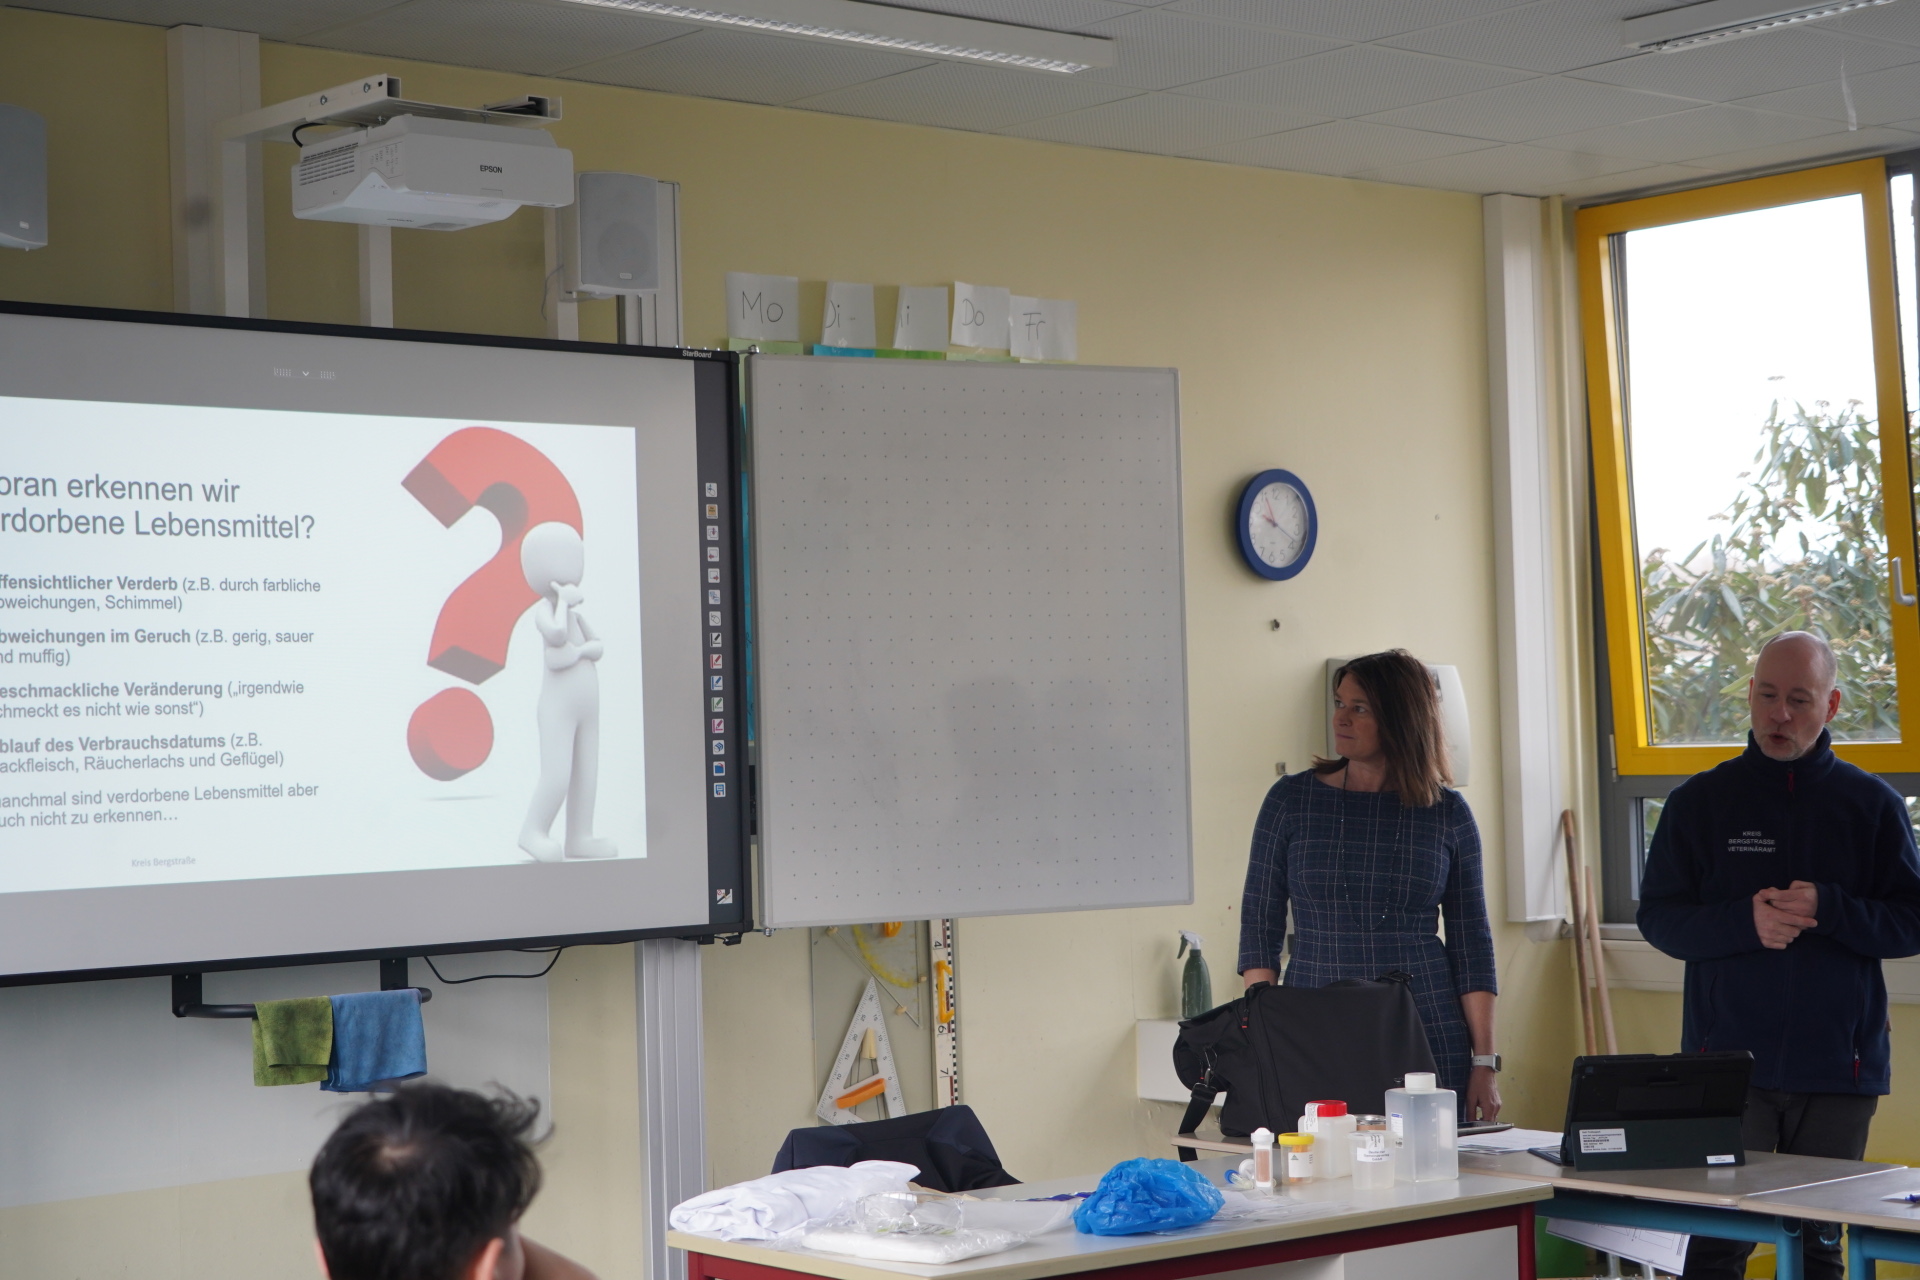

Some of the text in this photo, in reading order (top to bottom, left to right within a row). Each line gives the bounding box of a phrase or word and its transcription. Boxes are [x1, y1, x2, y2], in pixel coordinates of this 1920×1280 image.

[480, 164, 503, 174] EPSON
[742, 291, 783, 324] Mo
[962, 299, 985, 327] Do
[1023, 313, 1046, 341] Fr
[682, 350, 712, 359] StarBoard
[67, 473, 193, 502] erkennen
[201, 479, 240, 503] wir
[1, 507, 316, 539] rdorbene Lebensmittel?
[1269, 551, 1275, 563] 6
[117, 576, 178, 591] Verderb
[182, 577, 215, 594] (z.B.
[219, 577, 259, 592] durch
[263, 577, 321, 592] farbliche
[105, 595, 183, 613] Schimmel)
[110, 629, 129, 643] im
[134, 629, 191, 643] Geruch
[195, 629, 228, 646] (z.B.
[232, 629, 271, 646] gerig,
[275, 631, 314, 643] sauer
[19, 649, 71, 667] muffig)
[0, 683, 119, 698] eschmackliche
[124, 682, 223, 698] Veränderung
[63, 705, 81, 717] es
[85, 702, 121, 717] nicht
[125, 702, 150, 716] wie
[0, 732, 262, 754] blauf des Verbrauchsdatums (z.B.
[0, 750, 284, 773] ackfleisch, Räucherlachs und Geflügel)
[71, 790, 102, 806] sind
[106, 788, 190, 804] verdorbene
[194, 785, 283, 801] Lebensmittel
[287, 784, 319, 798] aber
[30, 811, 67, 826] nicht
[71, 812, 88, 825] zu
[131, 856, 196, 867] Kreis Bergstraße
